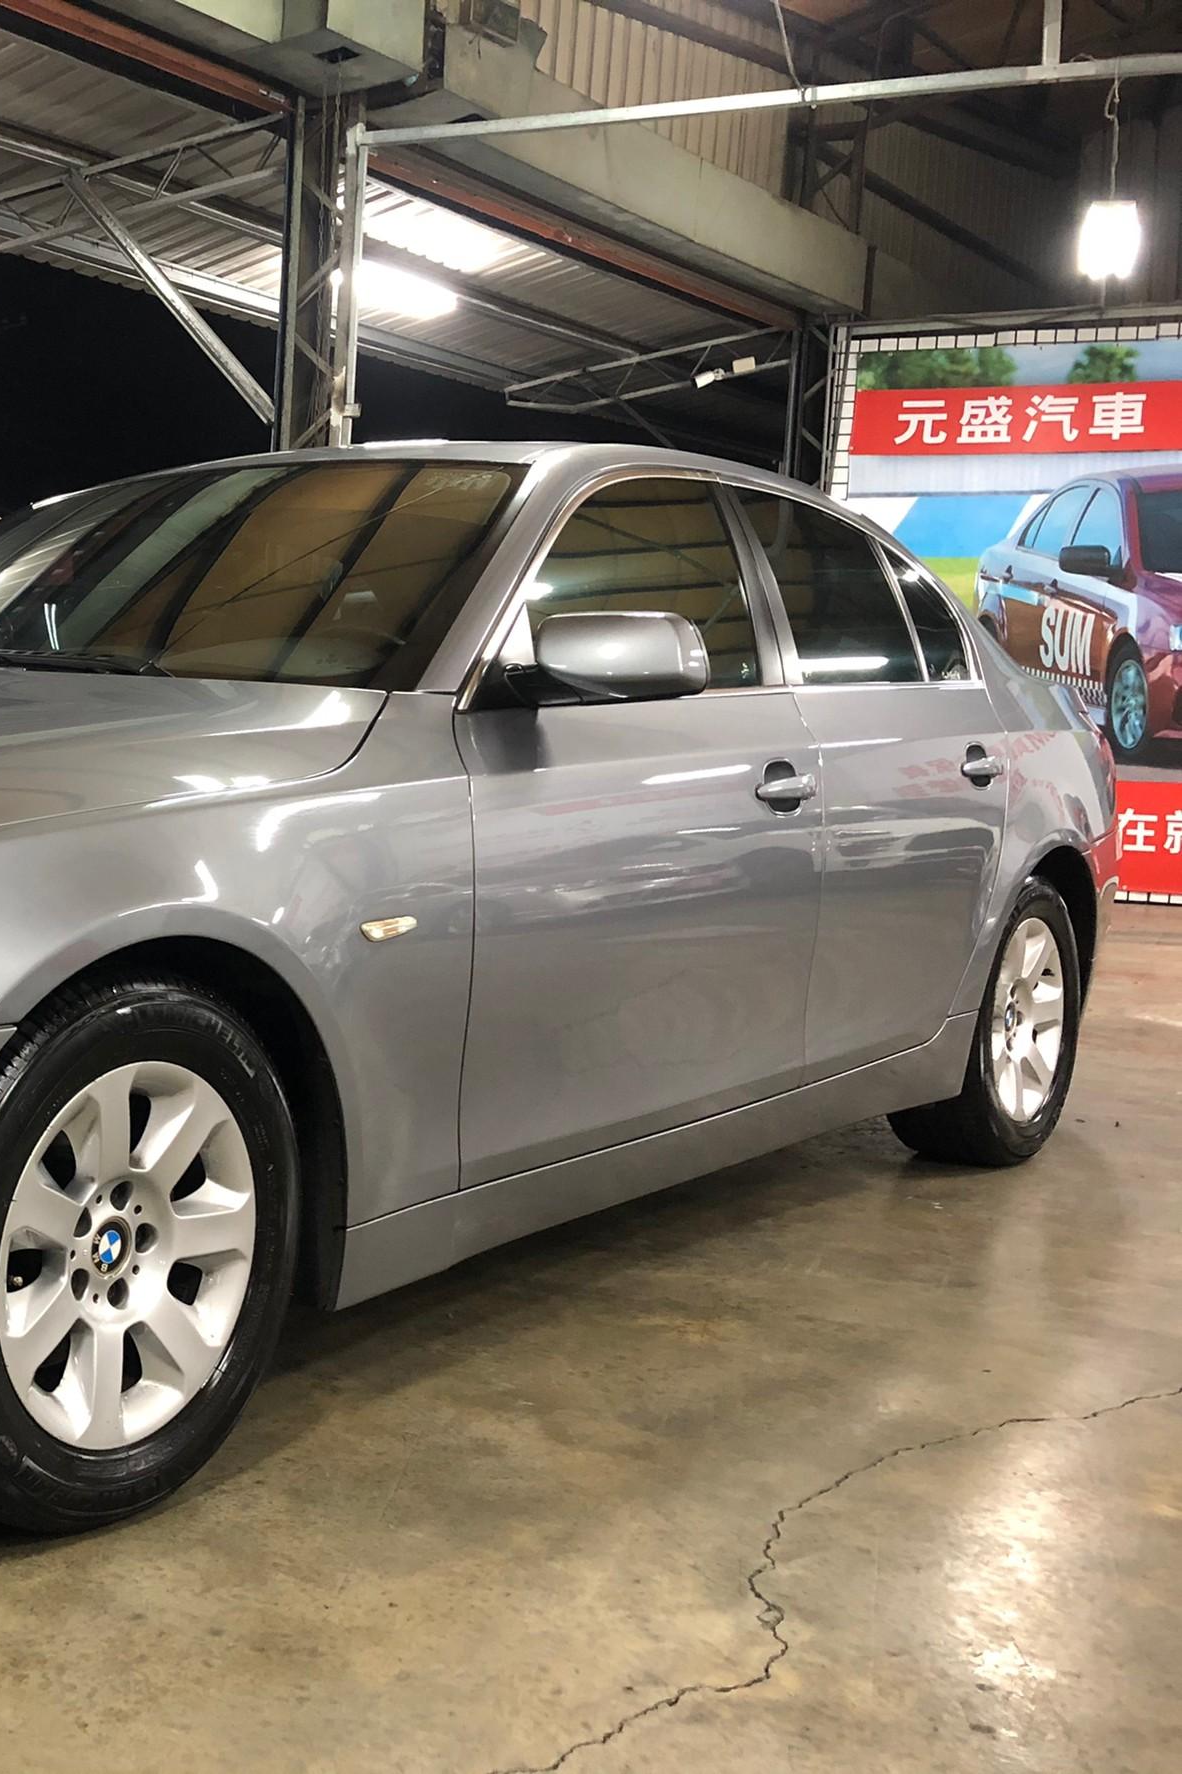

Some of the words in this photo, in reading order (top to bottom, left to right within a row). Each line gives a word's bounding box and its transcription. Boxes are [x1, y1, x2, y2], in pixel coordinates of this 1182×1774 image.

[893, 391, 1147, 446] 元盛汽車
[1039, 606, 1095, 677] SUM
